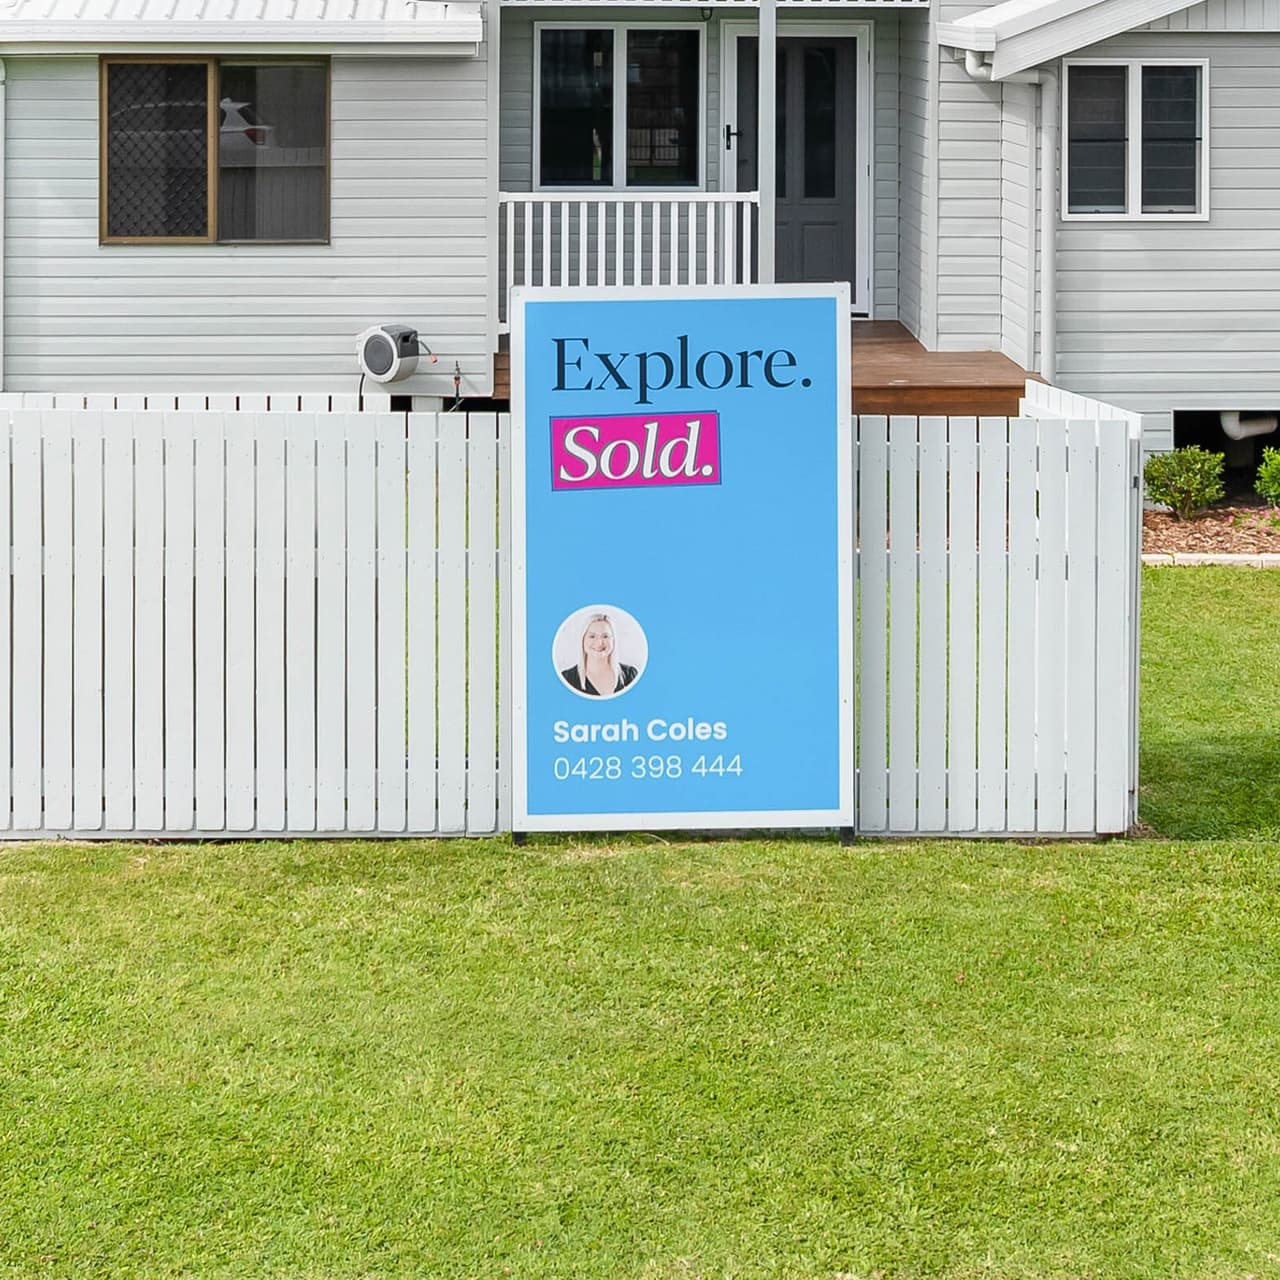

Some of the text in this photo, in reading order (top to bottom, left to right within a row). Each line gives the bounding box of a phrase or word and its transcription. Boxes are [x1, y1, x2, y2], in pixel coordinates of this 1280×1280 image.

[551, 334, 812, 405] Explore.
[558, 419, 714, 483] Sold.
[553, 717, 728, 743] Sarah Coles
[553, 753, 744, 780] 0428 398 444
